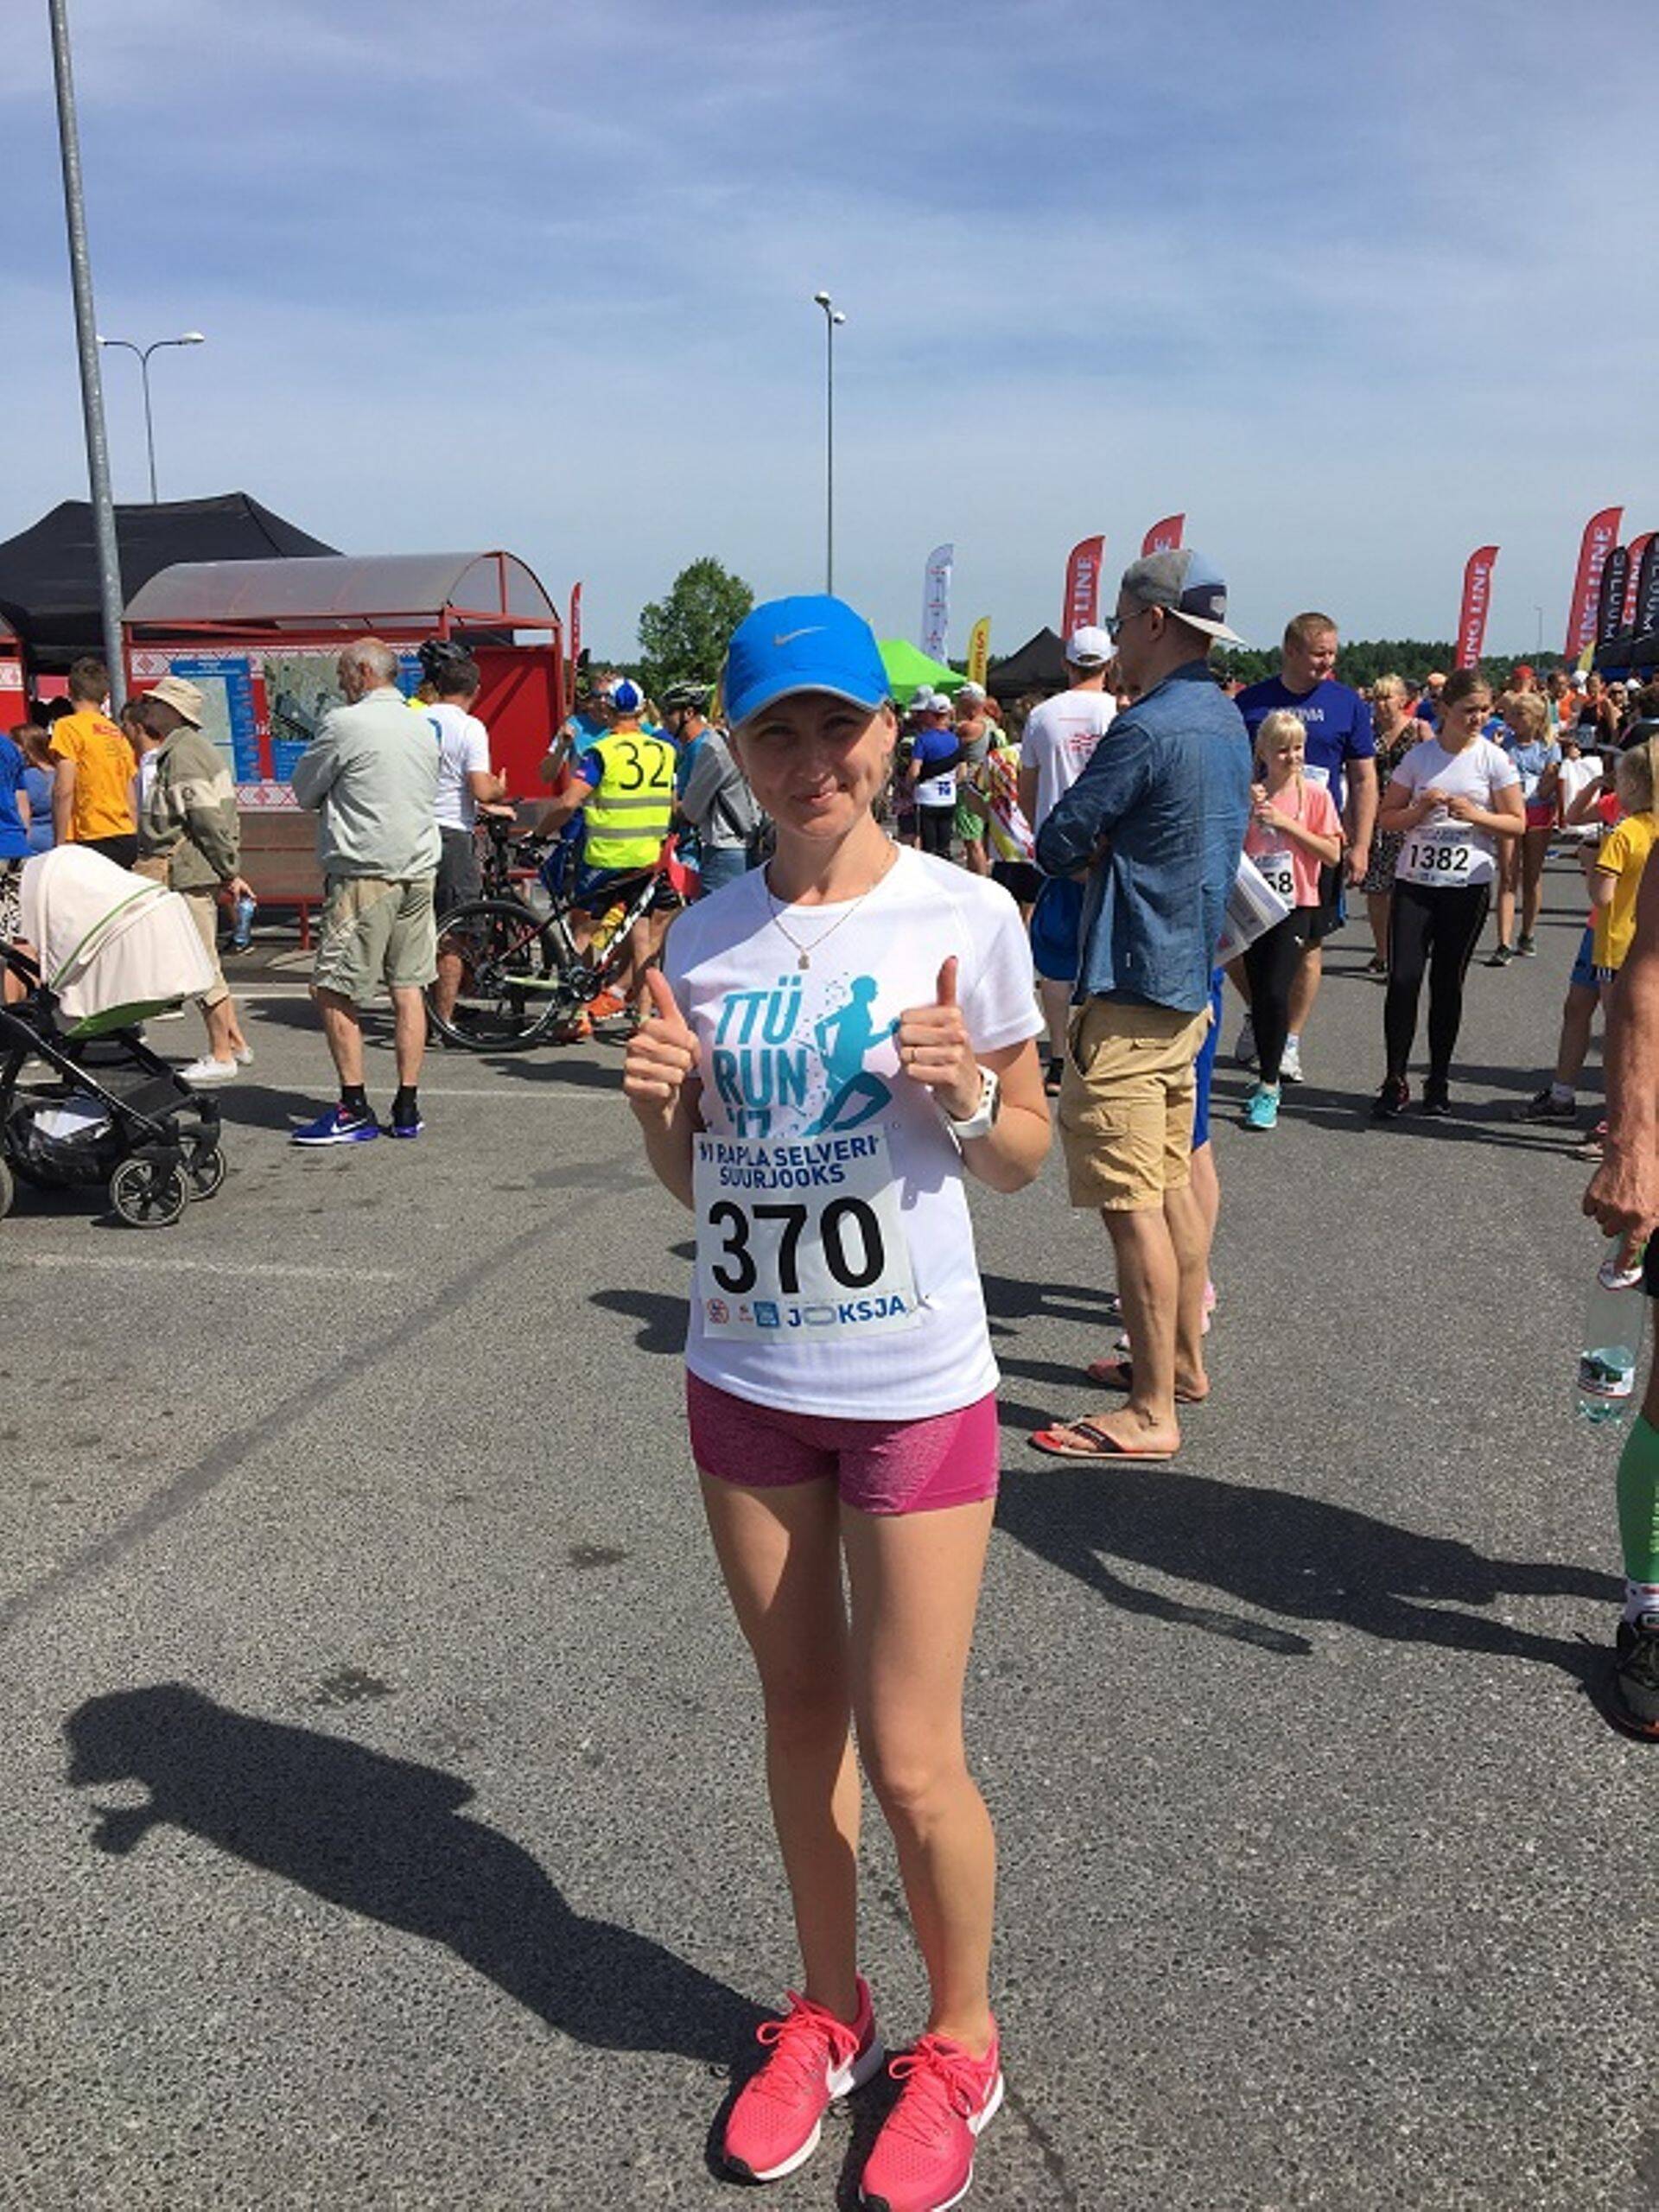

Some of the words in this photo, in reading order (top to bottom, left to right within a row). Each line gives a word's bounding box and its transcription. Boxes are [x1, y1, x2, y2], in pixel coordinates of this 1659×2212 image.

[1074, 554, 1093, 612] LINE
[1470, 562, 1490, 613] LINE
[614, 741, 669, 791] 32
[1411, 844, 1468, 871] 1382
[715, 975, 803, 1045] TTÜ
[713, 1048, 807, 1108] RUN
[717, 1144, 771, 1166] RAPLA
[772, 1135, 877, 1166] SELVERI
[720, 1163, 846, 1189] SUURJOOKS
[708, 1196, 885, 1294] 370
